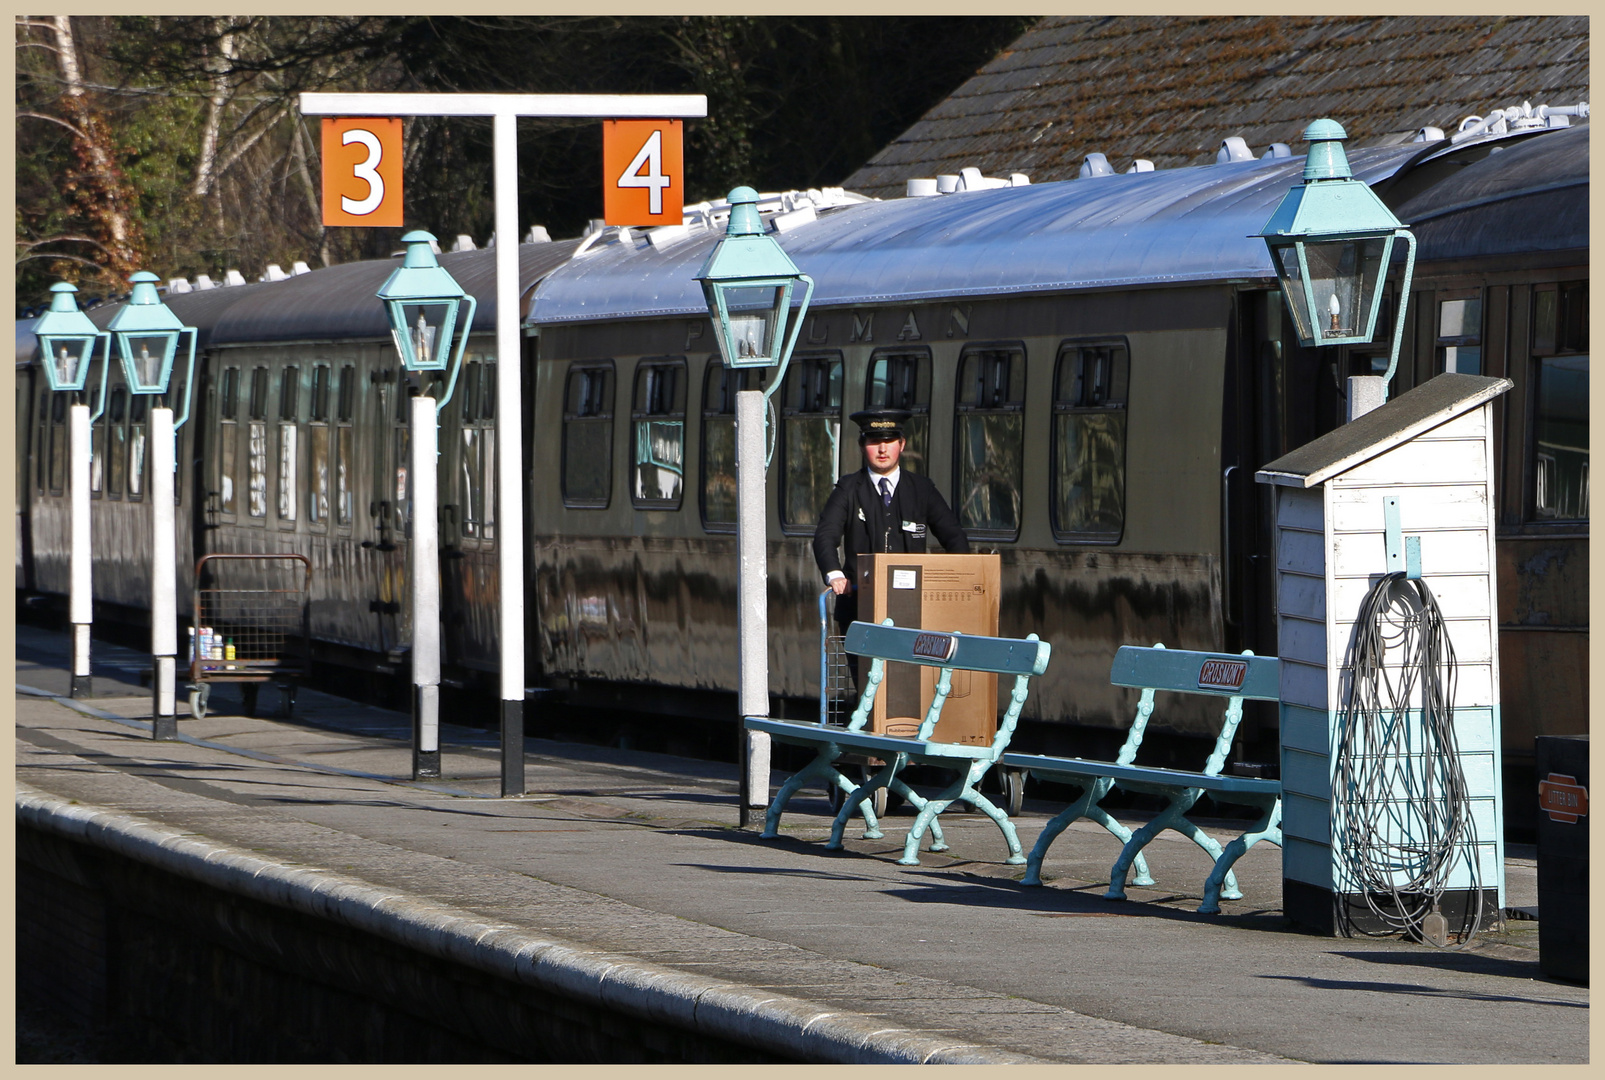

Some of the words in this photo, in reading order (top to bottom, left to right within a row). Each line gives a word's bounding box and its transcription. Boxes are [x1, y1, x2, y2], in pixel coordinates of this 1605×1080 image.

[341, 128, 386, 217] 3
[617, 128, 671, 215] 4
[684, 306, 973, 350] PLMAN
[1548, 790, 1566, 805] LITTER
[1568, 792, 1578, 807] BIN
